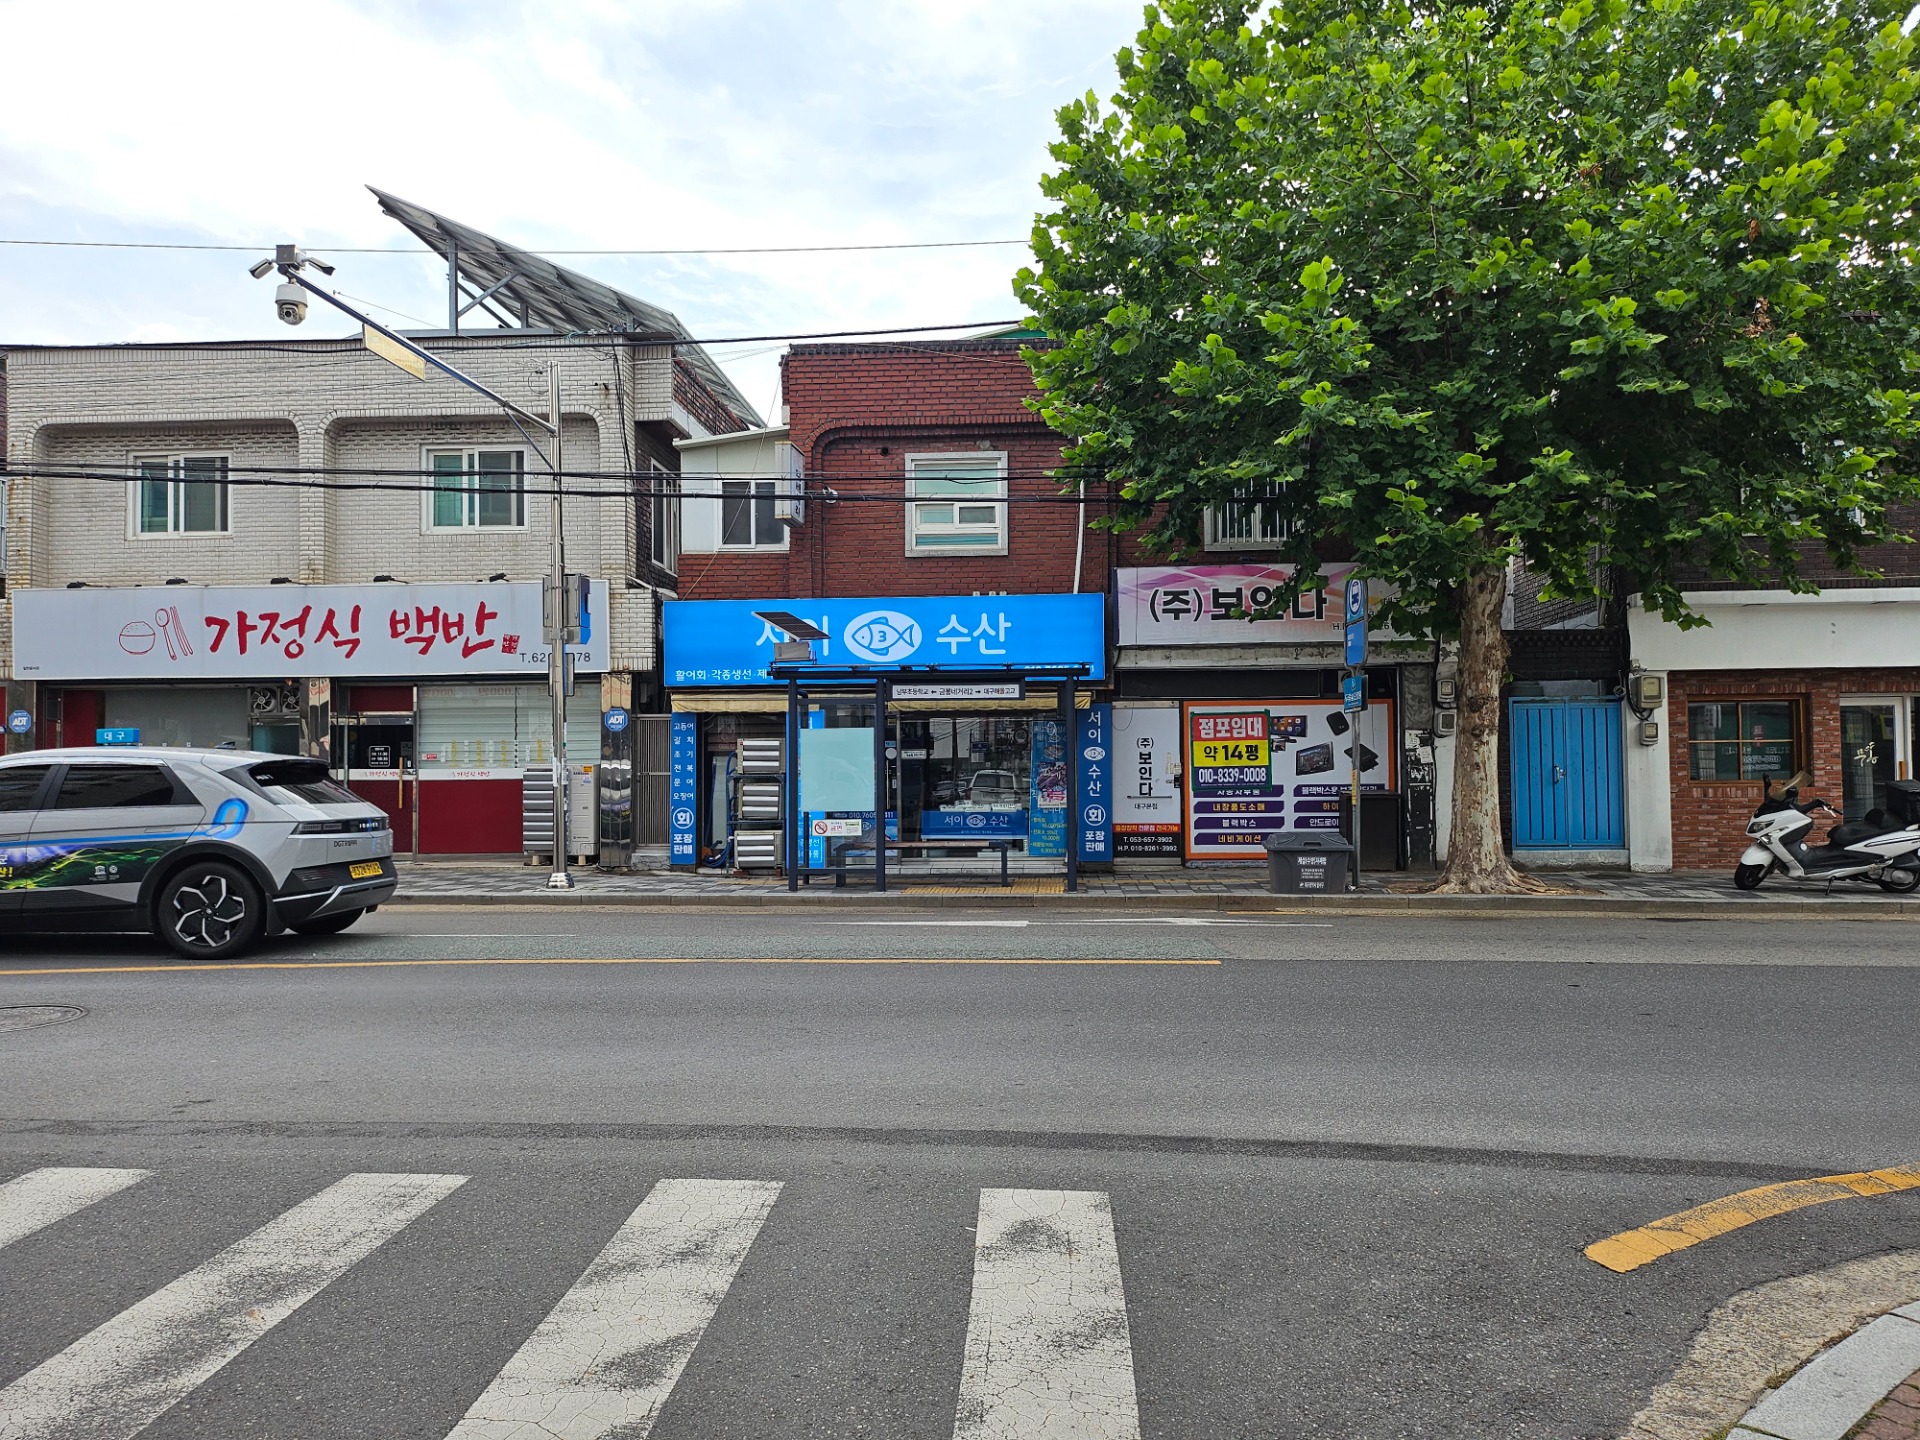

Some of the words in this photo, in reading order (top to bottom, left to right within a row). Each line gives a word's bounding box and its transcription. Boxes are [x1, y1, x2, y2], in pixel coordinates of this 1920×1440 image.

[204, 604, 362, 660] 가정식
[389, 600, 498, 659] 백반
[936, 612, 1012, 655] 수산
[12, 716, 28, 726] ADT
[608, 715, 624, 725] ADT
[673, 722, 694, 731] 고등어
[1198, 717, 1263, 739] 점포임대
[104, 731, 126, 741] 대구
[1204, 746, 1218, 761] 약
[1221, 744, 1259, 761] 14평
[1199, 767, 1267, 783] 010-8339-0008
[672, 792, 694, 801] 오징어
[676, 811, 690, 825] 회
[1088, 808, 1102, 822] 회
[944, 815, 964, 827] 서이
[989, 815, 1009, 827] 수산
[1309, 818, 1339, 827] 안드로이
[673, 833, 693, 844] 포장
[1085, 830, 1105, 841] 포장
[673, 844, 693, 855] 판매
[1085, 842, 1105, 852] 판매
